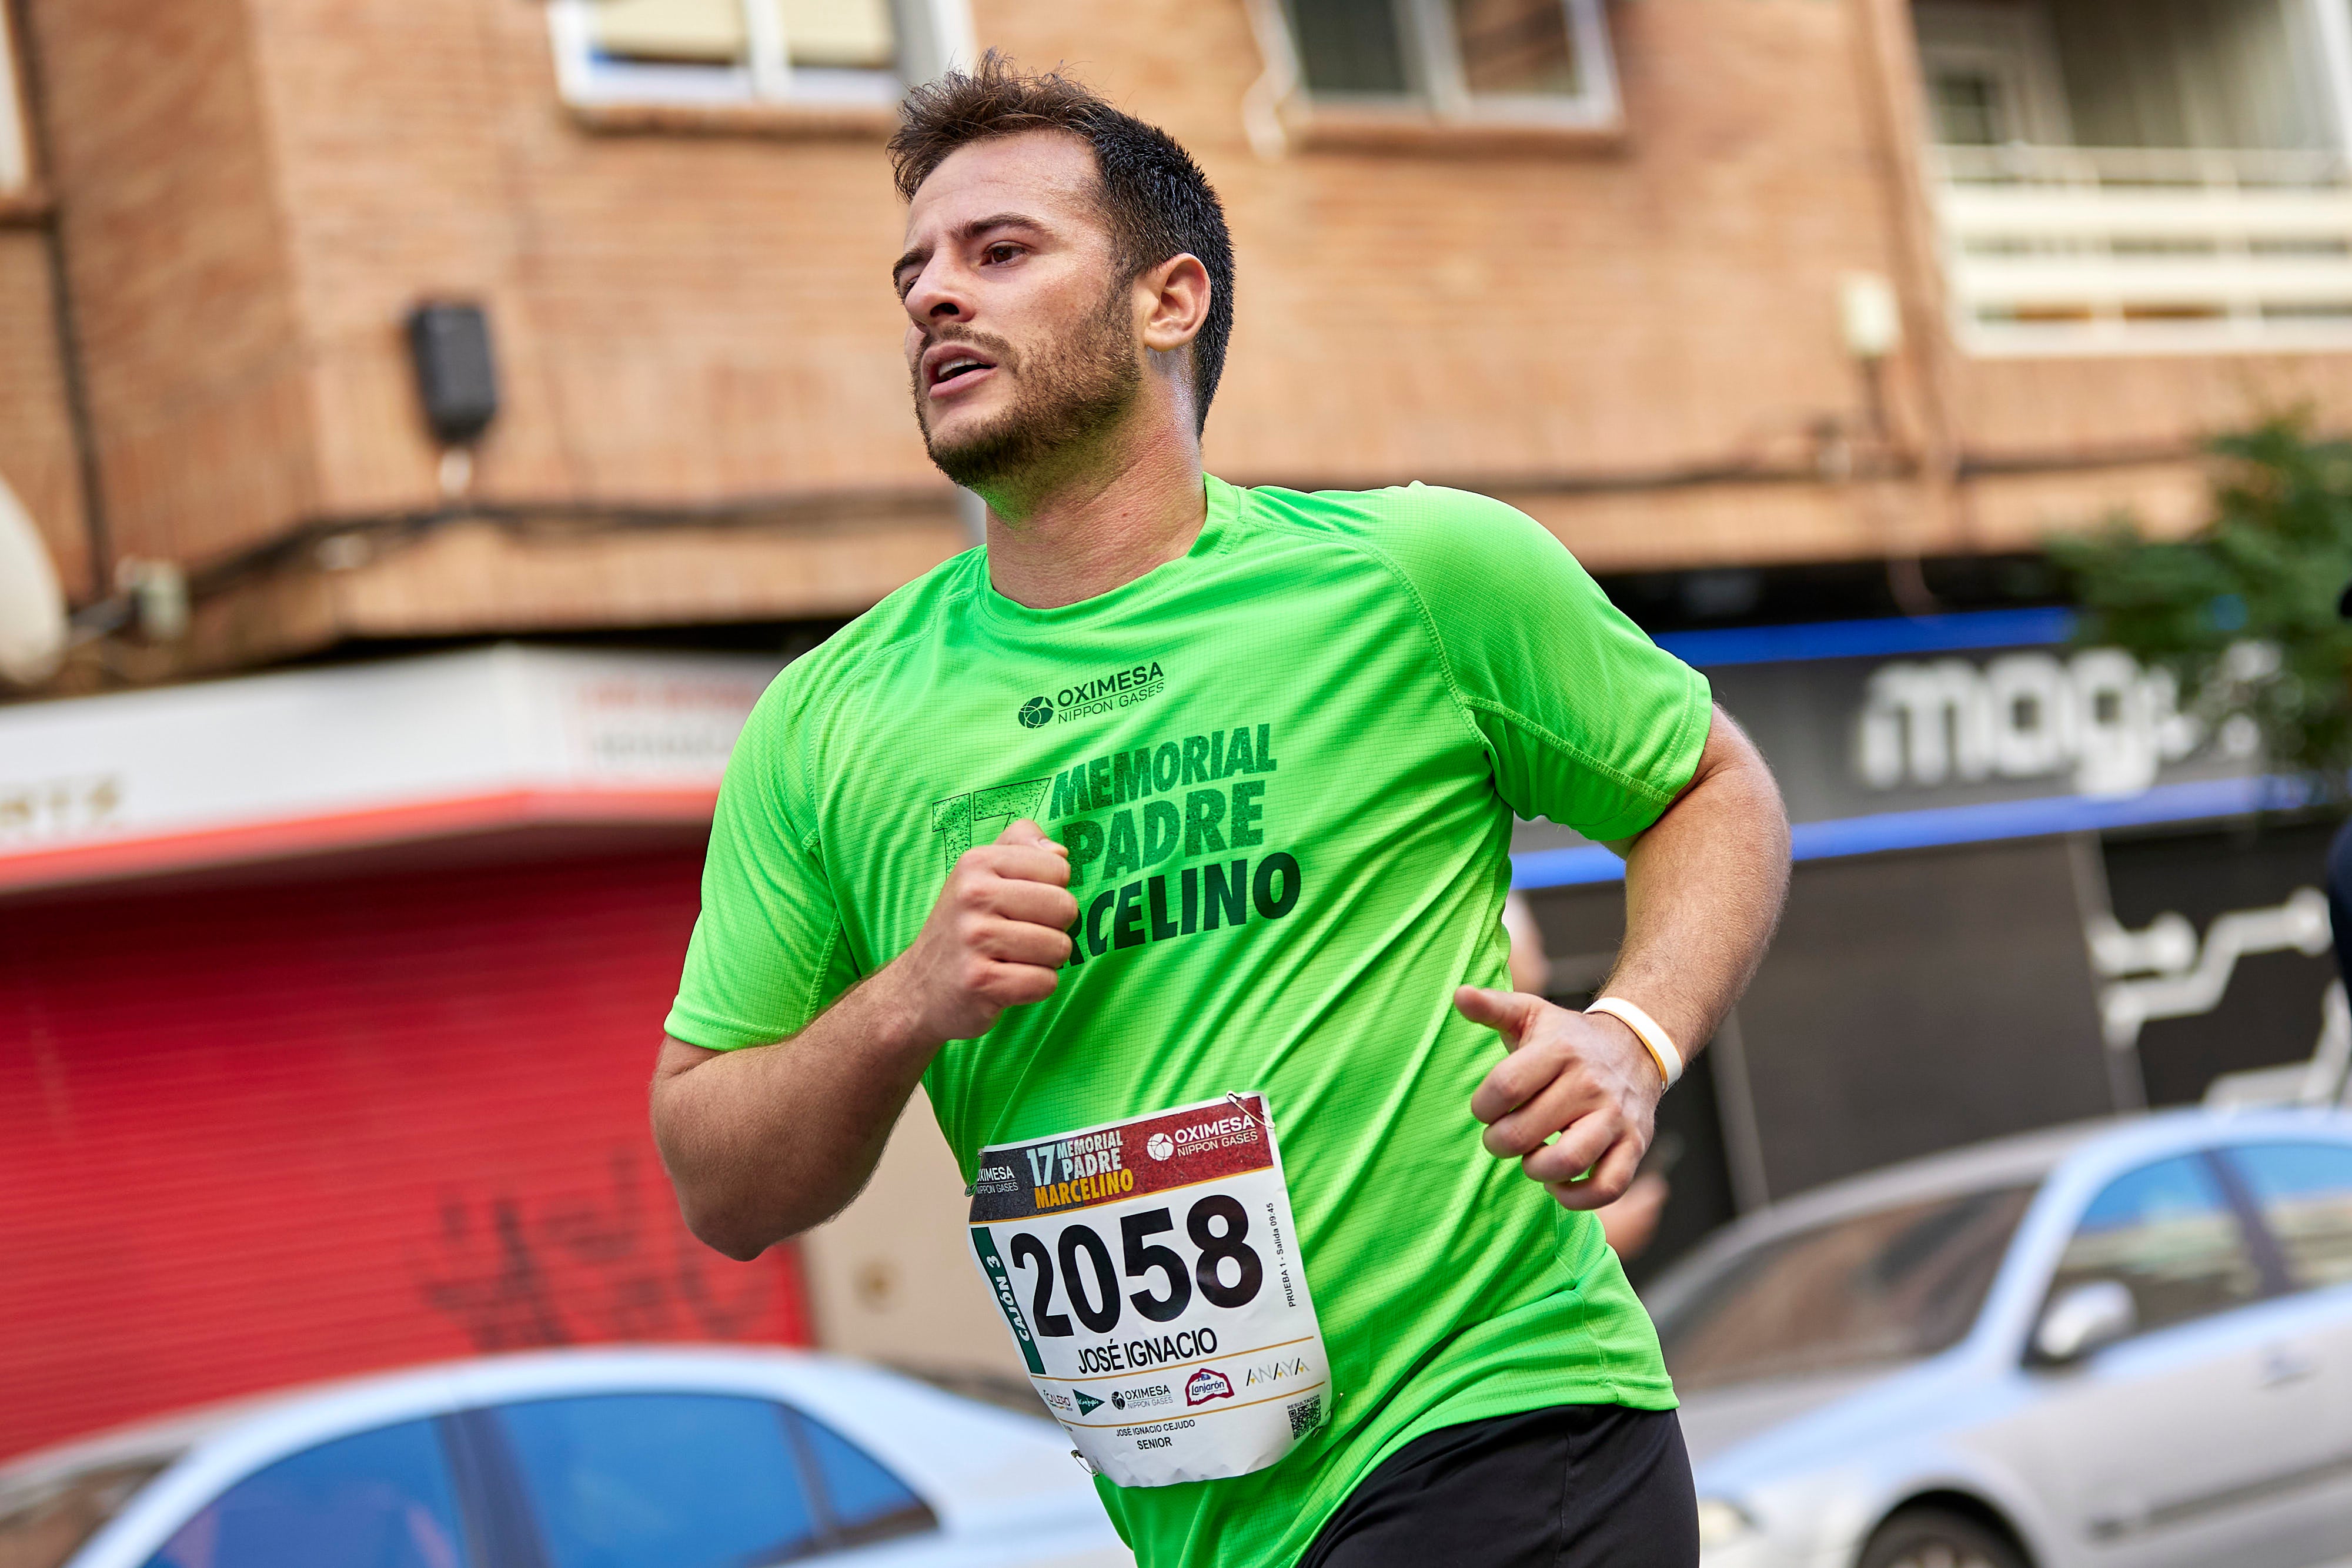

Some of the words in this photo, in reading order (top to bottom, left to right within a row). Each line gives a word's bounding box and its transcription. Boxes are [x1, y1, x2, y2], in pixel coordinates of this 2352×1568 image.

[1057, 661, 1164, 707] OXIMESA
[1058, 699, 1113, 724] NIPPON
[1118, 682, 1164, 707] GASES
[1048, 723, 1277, 822] MEMORIAL
[1061, 779, 1266, 888] PADRE
[1174, 1115, 1256, 1144] OXIMESA
[1177, 1141, 1218, 1157] NIPPON
[1221, 1131, 1258, 1148] GASES
[1056, 1130, 1124, 1159] MEMORIAL
[1025, 1144, 1056, 1187] 17
[1061, 1147, 1122, 1182] PADRE
[996, 1182, 1018, 1193] GASES
[1034, 1168, 1134, 1209] MARCELINO
[1266, 1202, 1278, 1226] 09:45
[1272, 1228, 1284, 1255] Salida
[986, 1255, 1001, 1269] 3
[1010, 1193, 1264, 1338] 2058
[1281, 1269, 1296, 1308] PRUEBA
[995, 1276, 1030, 1342] CAJÓN
[1078, 1338, 1125, 1375] JOSÉ
[1126, 1327, 1218, 1370] IGNACIO
[1246, 1358, 1310, 1386] ANAYA
[1125, 1385, 1171, 1400] OXIMESA
[1127, 1400, 1151, 1410] NIPPON
[1152, 1395, 1174, 1406] GASES
[1191, 1380, 1225, 1396] Lanjarón
[1287, 1393, 1320, 1410] RESULTADOS
[1116, 1426, 1132, 1437] JOSÉ
[1133, 1424, 1162, 1436] IGNACIO
[1163, 1419, 1195, 1432] CEJUDO
[1137, 1436, 1173, 1450] SENIOR
